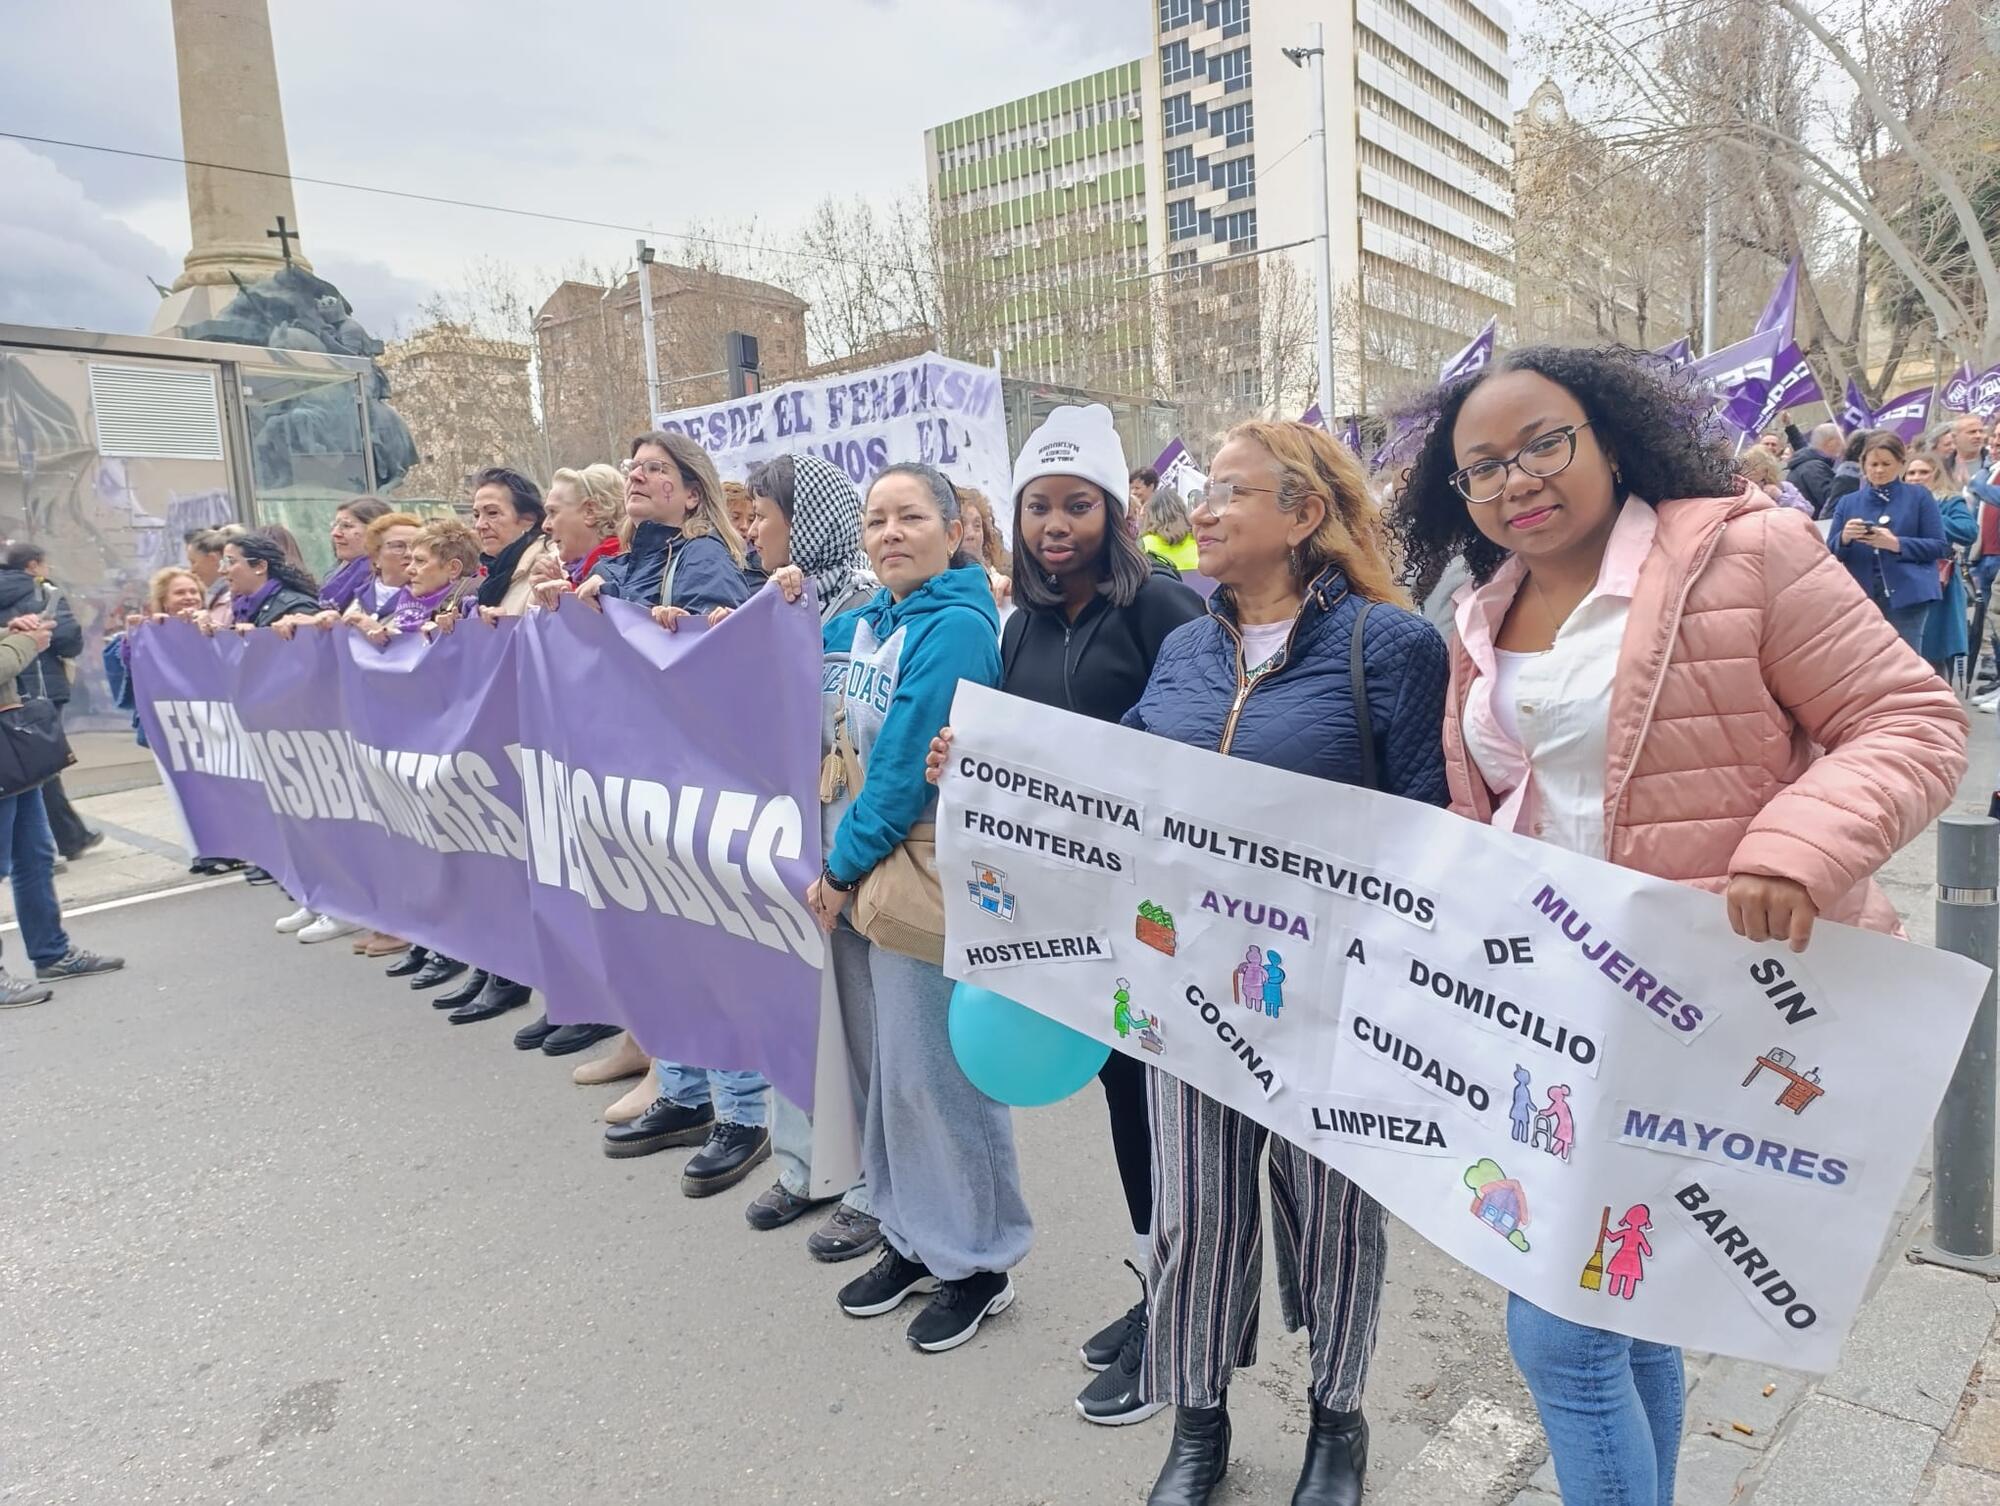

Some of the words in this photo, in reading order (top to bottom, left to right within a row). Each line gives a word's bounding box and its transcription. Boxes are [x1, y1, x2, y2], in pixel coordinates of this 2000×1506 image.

[774, 391, 812, 437] EL
[964, 810, 1122, 872] FRONTERAS
[960, 757, 1140, 832] COOPERATIVA
[1163, 817, 1435, 924] MULTISERVICIOS
[1483, 937, 1534, 965] DE
[1531, 884, 1703, 1032] MUJERES
[1750, 957, 1817, 1026] SIN
[966, 936, 1102, 966] HOSTELERIA
[1201, 890, 1311, 941] AYUDA
[1346, 939, 1366, 964] A
[1410, 959, 1597, 1066] DOMICILIO
[1186, 985, 1275, 1094] COCINA
[1353, 1016, 1489, 1112] CUIDADO
[1312, 1108, 1447, 1149] LIMPIEZA
[1624, 1110, 1849, 1186] MAYORES
[1675, 1182, 1817, 1330] BARRIDO
